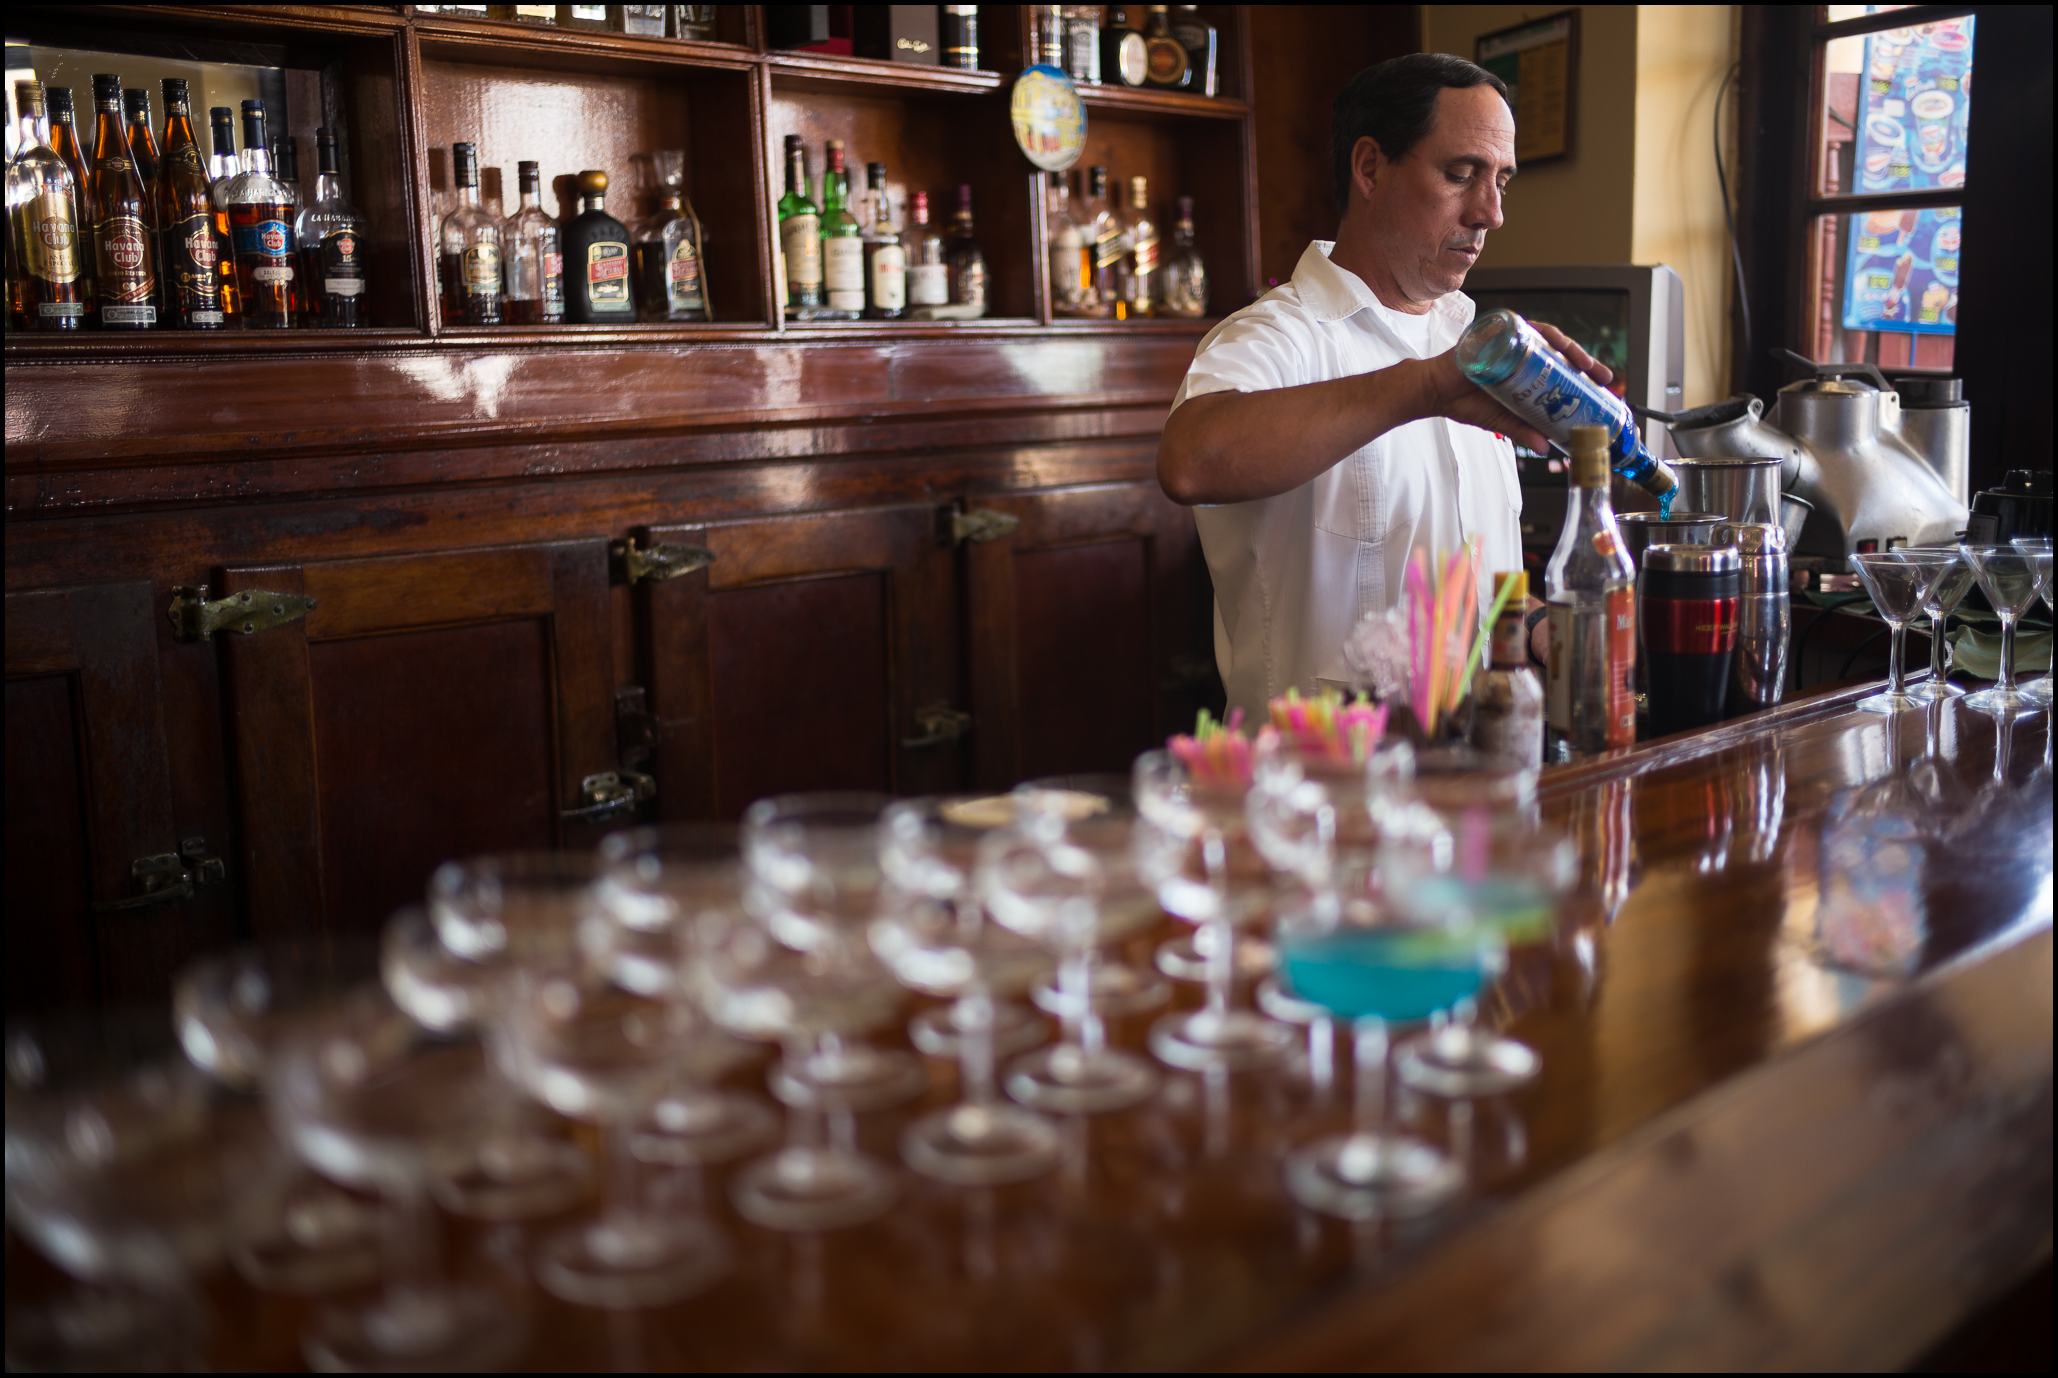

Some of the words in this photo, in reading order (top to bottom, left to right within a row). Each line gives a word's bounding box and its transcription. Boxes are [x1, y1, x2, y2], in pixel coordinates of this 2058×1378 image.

[32, 221, 75, 233] Havana
[44, 233, 71, 245] Club
[184, 237, 218, 249] Havan
[104, 240, 145, 252] Havana
[113, 252, 140, 263] Club
[194, 250, 217, 262] Club
